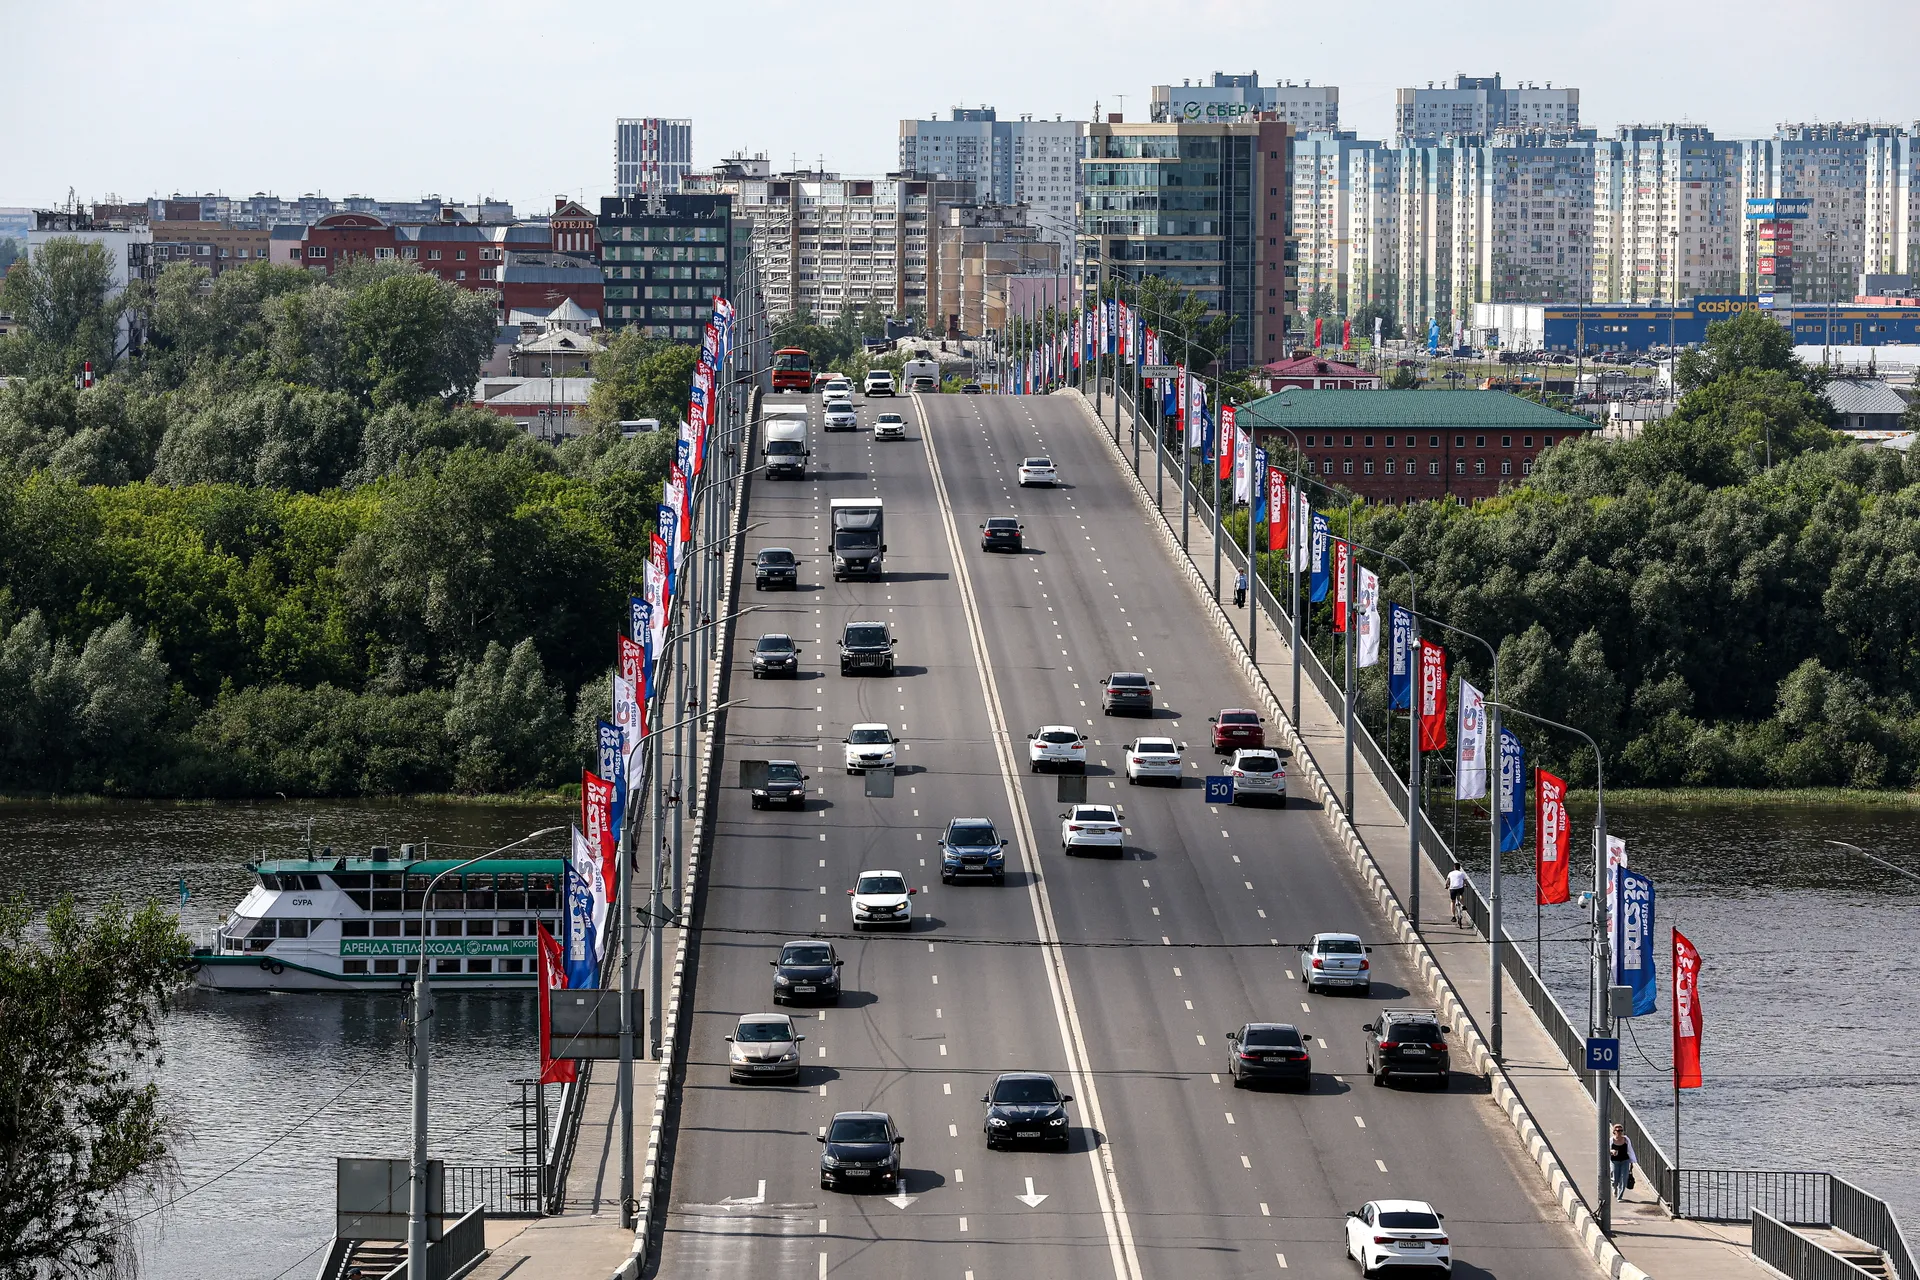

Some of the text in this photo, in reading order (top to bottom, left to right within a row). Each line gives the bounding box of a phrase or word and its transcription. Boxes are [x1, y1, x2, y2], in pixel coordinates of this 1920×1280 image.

[1206, 105, 1247, 116] СБЕР
[553, 221, 593, 229] ОТЕЛЬ
[1393, 609, 1406, 675] BRICS'20
[1432, 648, 1441, 665] 24
[1423, 646, 1436, 715] BRICS'20
[614, 749, 622, 775] RUSSIA
[1501, 734, 1513, 812] BRICS'20
[1211, 784, 1228, 796] 50
[1542, 781, 1557, 861] BRICS'20
[1637, 880, 1649, 900] 24
[1624, 877, 1641, 970] BRICS'20
[343, 943, 463, 954] АРЕНДА ТЕПЛОХОДА
[1593, 1047, 1613, 1061] 50
